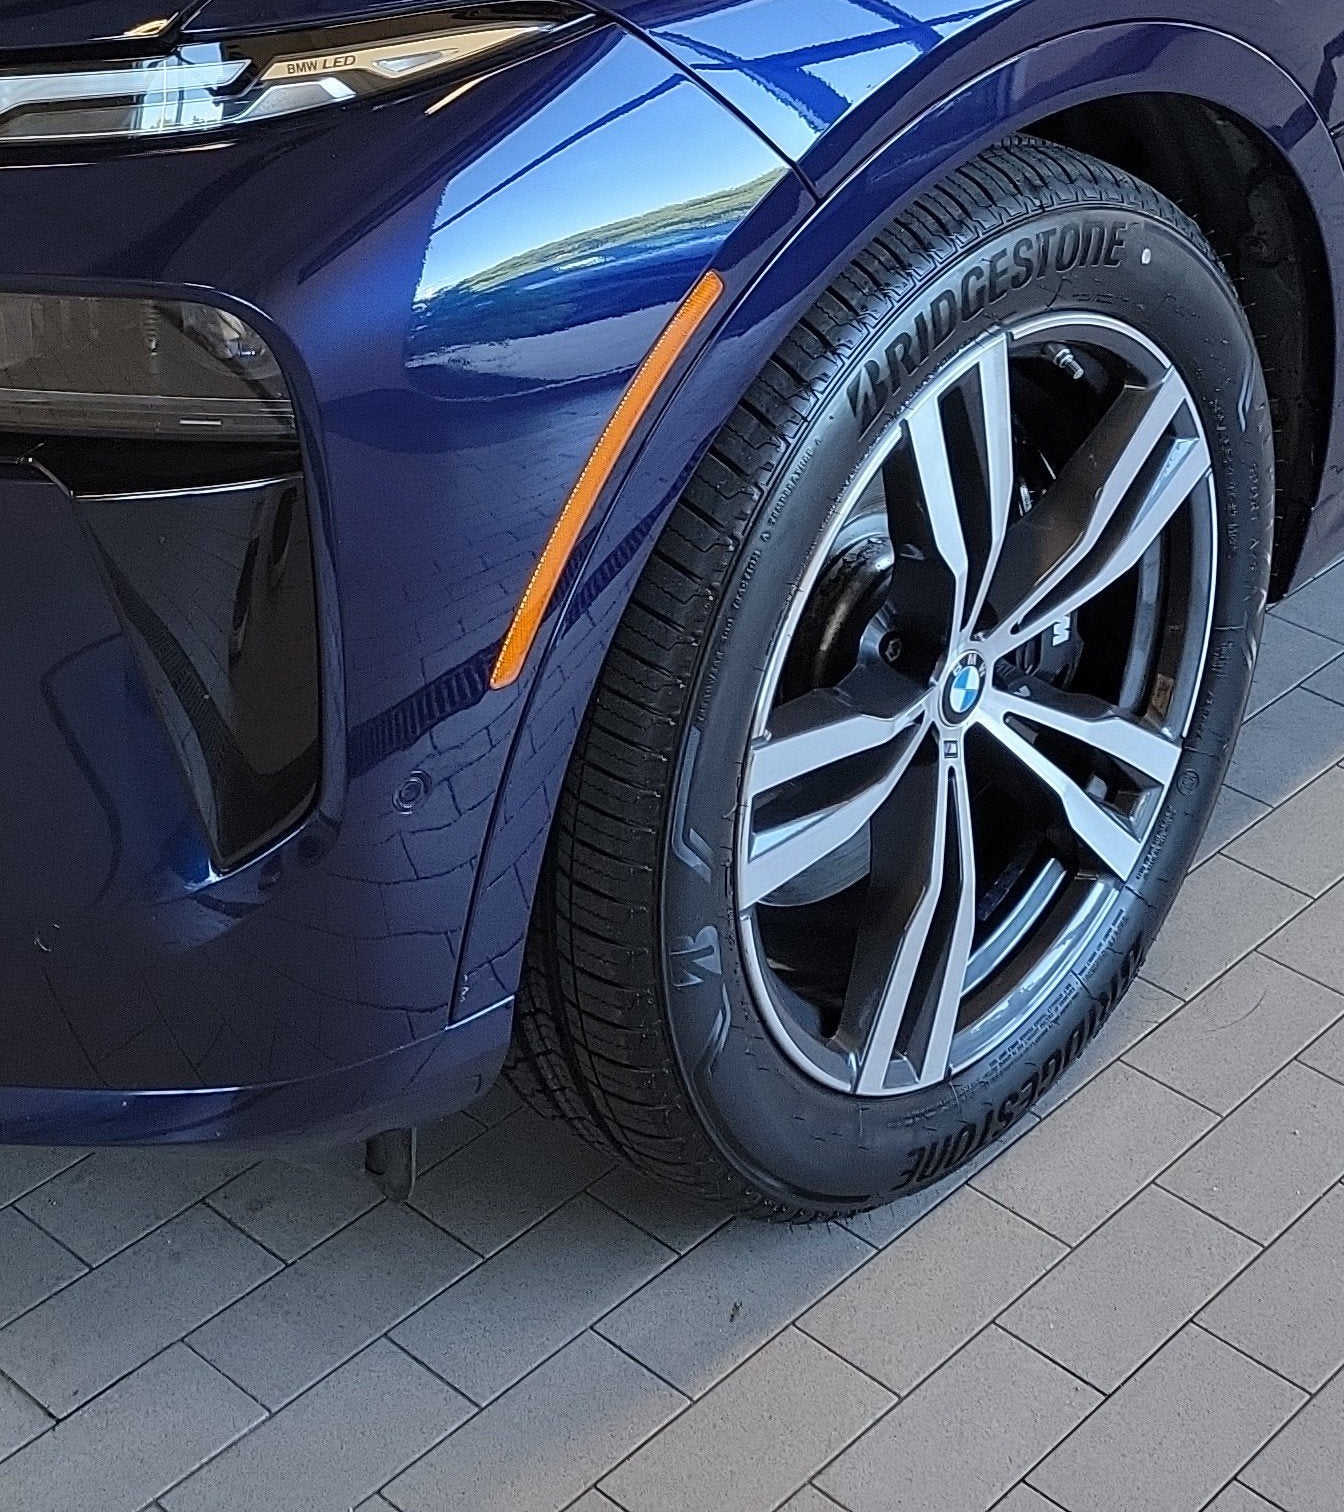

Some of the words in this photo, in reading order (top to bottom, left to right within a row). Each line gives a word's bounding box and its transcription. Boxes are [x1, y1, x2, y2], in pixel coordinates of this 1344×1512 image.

[287, 59, 318, 74] BMW
[322, 55, 356, 70] LED
[846, 220, 1127, 440] BRIDGESTONE
